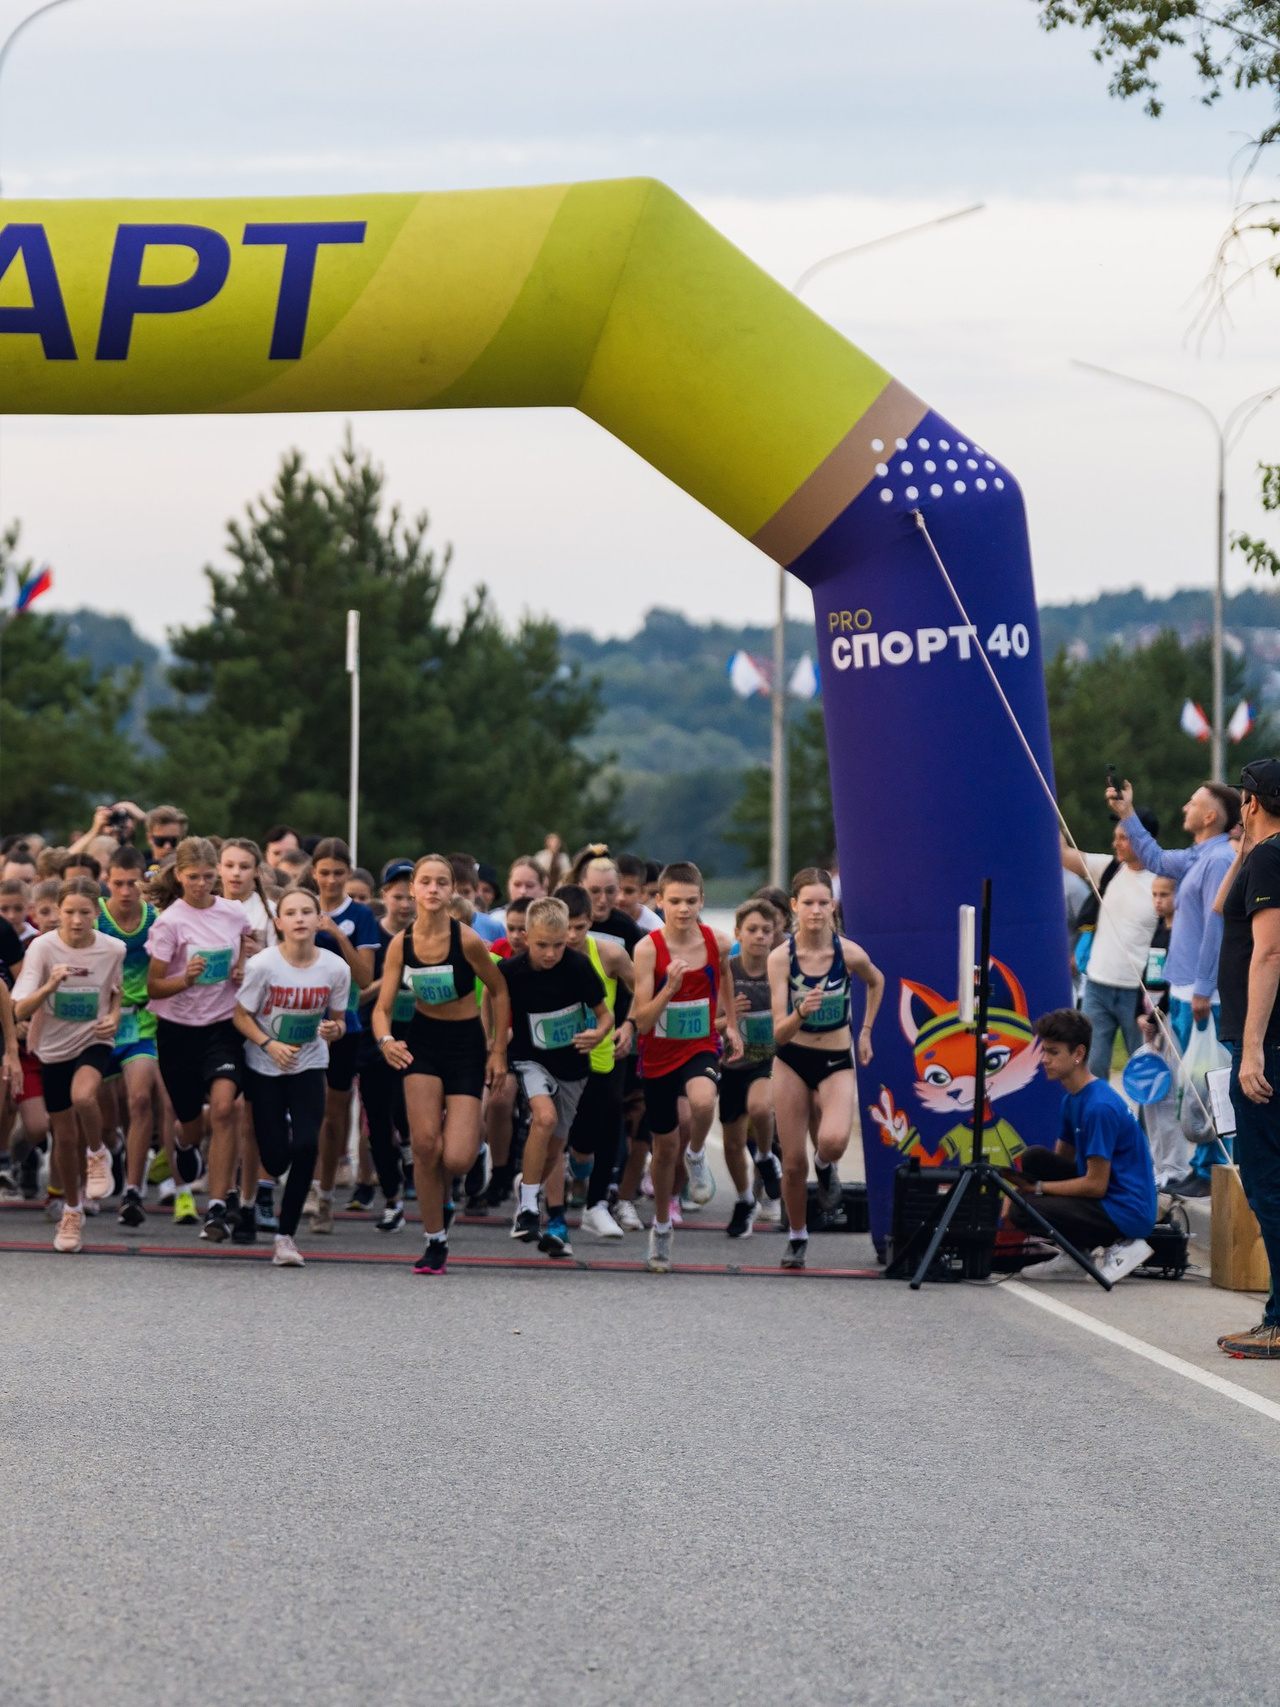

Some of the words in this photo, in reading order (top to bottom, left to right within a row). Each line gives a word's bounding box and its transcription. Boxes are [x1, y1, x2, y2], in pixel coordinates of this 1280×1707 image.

[828, 608, 873, 633] PRO
[831, 624, 978, 671] СПОРТ
[986, 622, 1031, 659] 40
[420, 984, 453, 1001] 3610
[677, 1017, 703, 1035] 710
